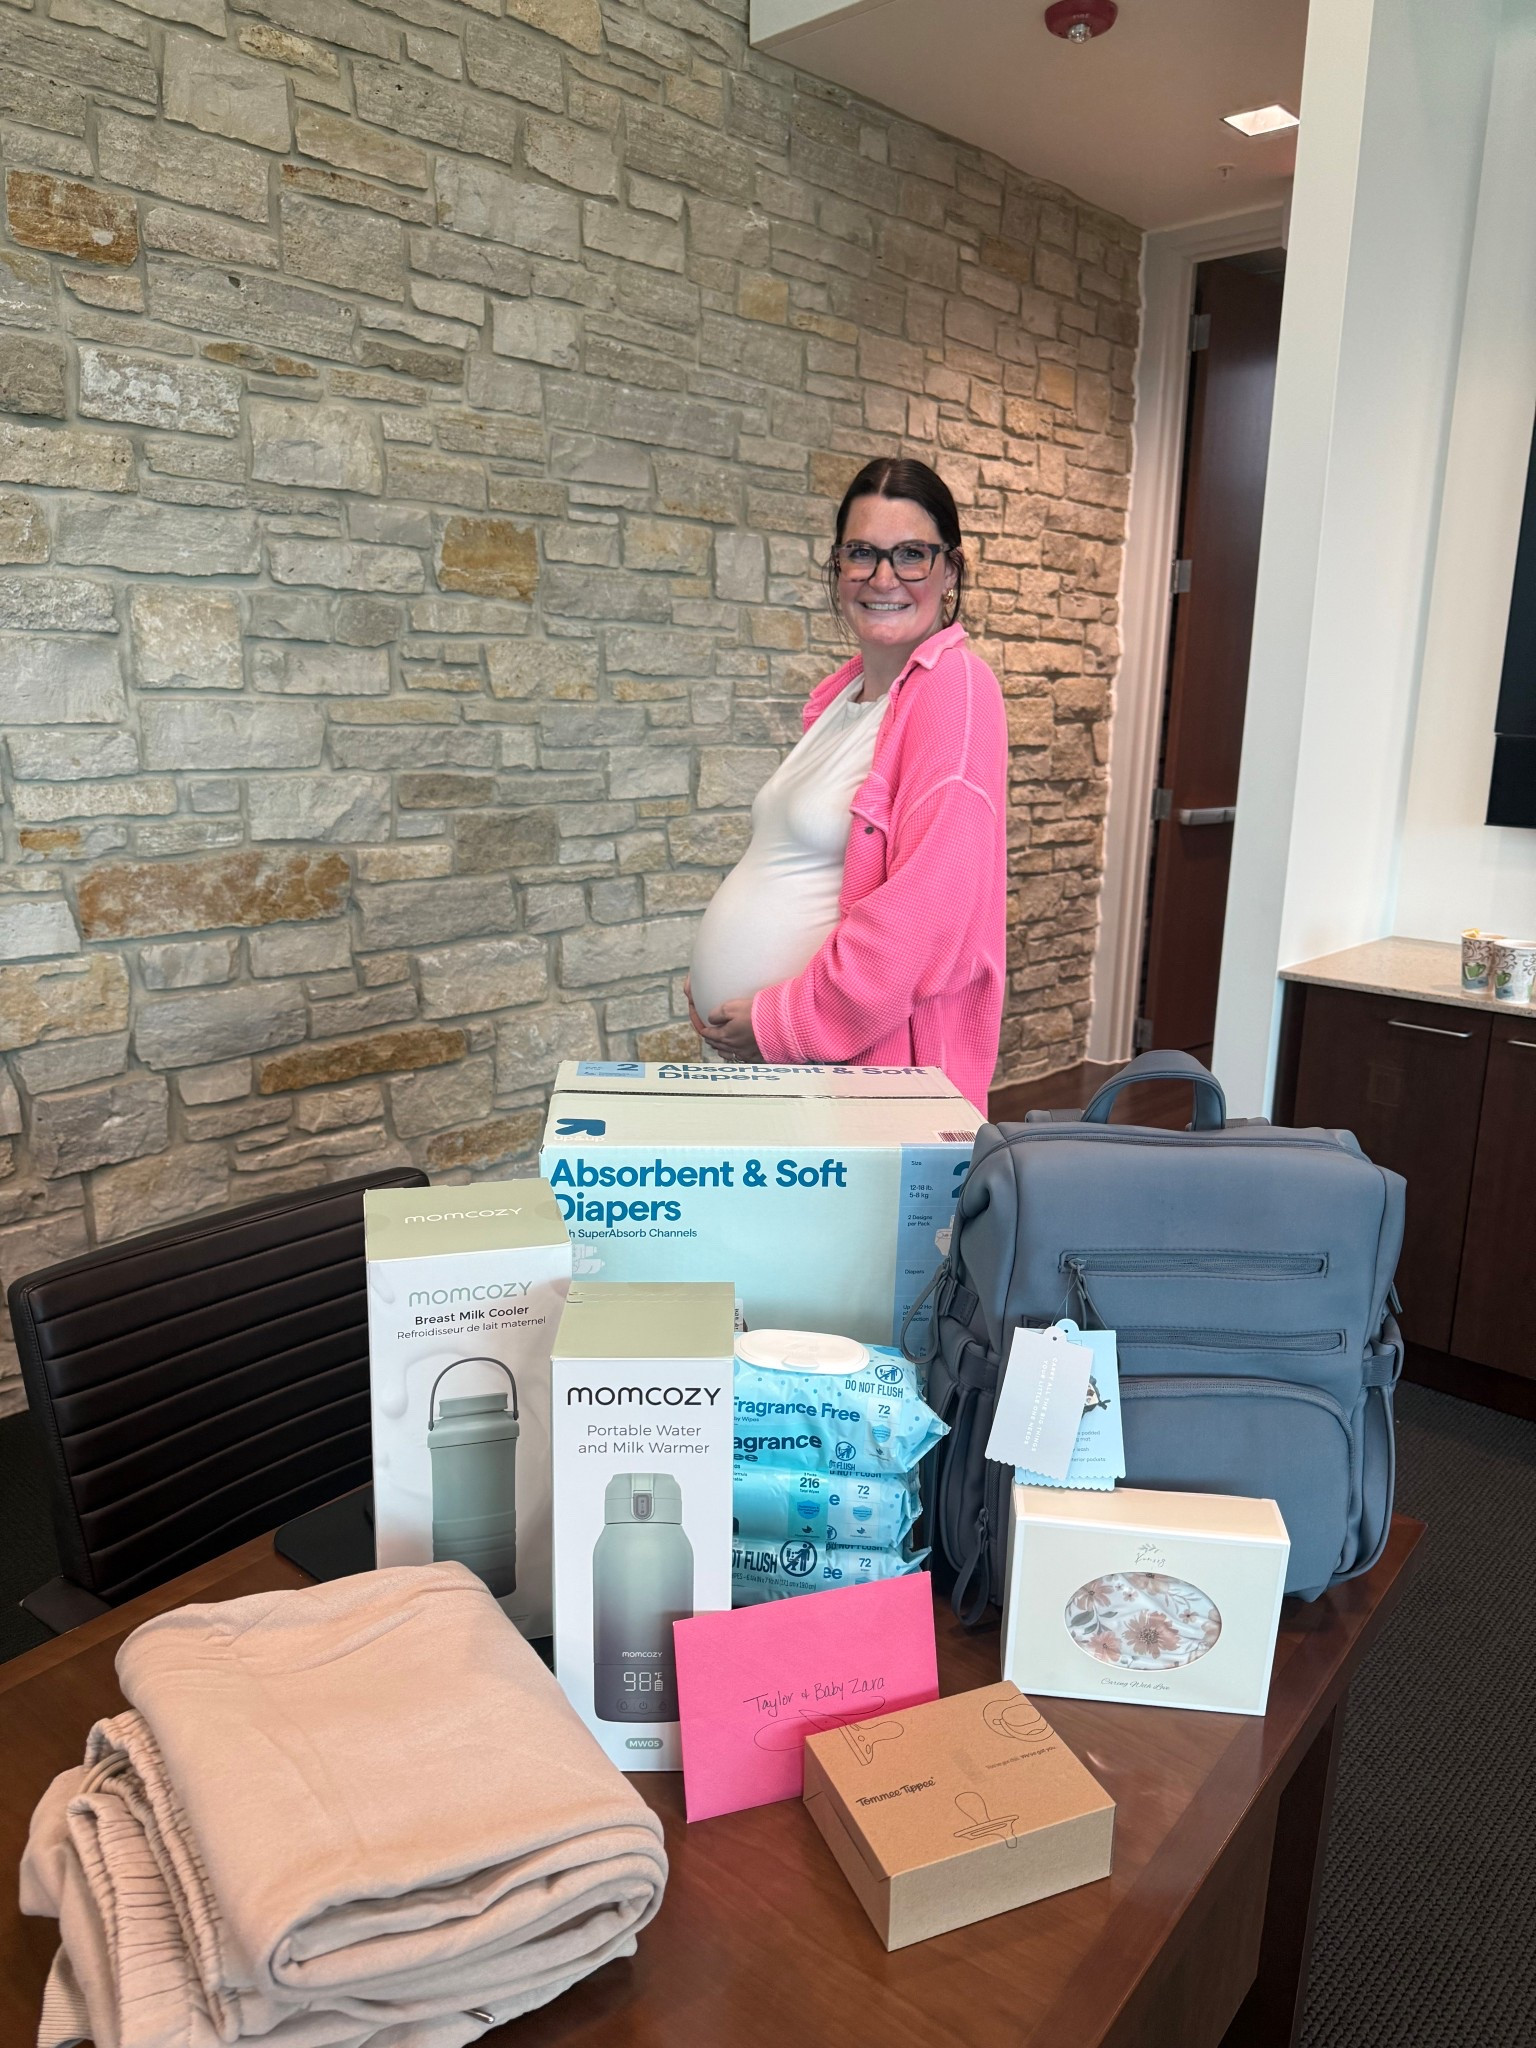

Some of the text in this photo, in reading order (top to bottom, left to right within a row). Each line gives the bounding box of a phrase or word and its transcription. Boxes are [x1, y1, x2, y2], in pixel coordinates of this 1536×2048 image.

[617, 1063, 639, 1072] 2
[658, 1064, 928, 1075] Absorbent & Soft
[658, 1072, 781, 1082] Diapers
[550, 1158, 848, 1189] Absorbent & Soft
[554, 1191, 682, 1229] Diapers
[578, 1228, 648, 1240] SuperAbsorb
[649, 1228, 698, 1238] Channels
[415, 1305, 530, 1326] Breast Milk Cooler
[397, 1316, 547, 1340] Refroidisseur de lait maternel
[1049, 1357, 1058, 1381] CARRY
[845, 1379, 904, 1399] DO NOT FLUSH
[1034, 1380, 1043, 1404] LITTLE
[1045, 1382, 1053, 1395] ALL
[821, 1402, 861, 1423] Free
[878, 1404, 891, 1415] 72
[1030, 1405, 1038, 1420] ONE
[587, 1424, 702, 1437] Portable Water
[1024, 1422, 1034, 1445] NEEDS
[1031, 1426, 1042, 1452] THINGS
[578, 1441, 710, 1454] and Milk Warmer
[734, 1434, 823, 1453] agrance
[799, 1476, 820, 1489] 216
[857, 1484, 870, 1495] 72
[732, 1548, 778, 1574] OT FLUSH
[858, 1557, 872, 1568] 72
[623, 1671, 652, 1692] 98
[1100, 1677, 1129, 1688] Caring
[1130, 1680, 1152, 1689] With
[742, 1690, 794, 1718] Taylor
[814, 1681, 844, 1701] Baby
[848, 1676, 885, 1694] Zara
[629, 1740, 660, 1748] MW05
[856, 1777, 936, 1807] Tommee Tippee
